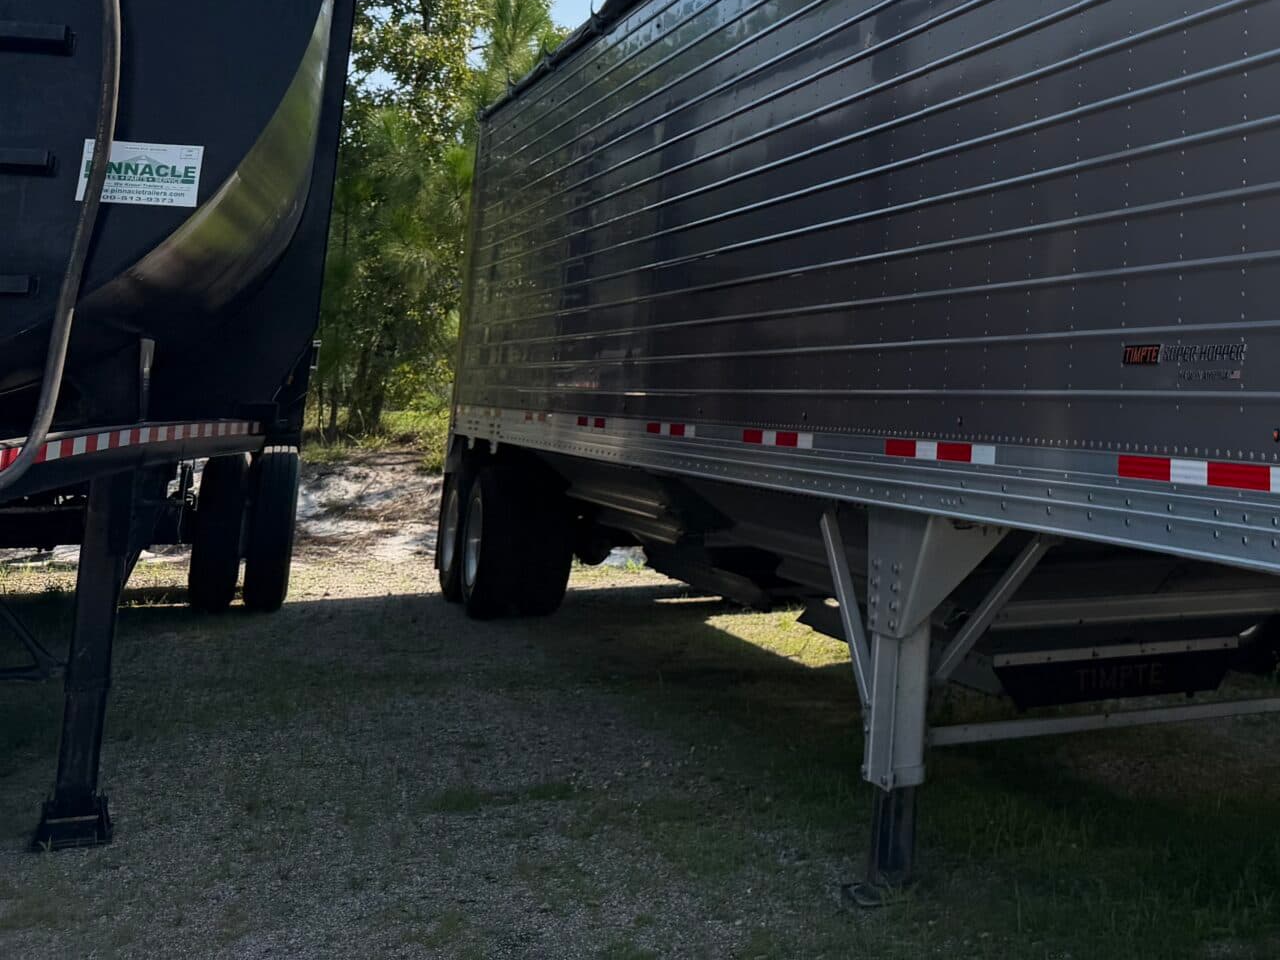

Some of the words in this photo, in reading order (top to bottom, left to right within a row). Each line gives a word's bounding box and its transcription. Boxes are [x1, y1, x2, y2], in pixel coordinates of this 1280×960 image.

[102, 194, 174, 203] 00-513-9373
[1125, 346, 1159, 362] TIMPTE
[1074, 663, 1164, 690] TIMPTE
